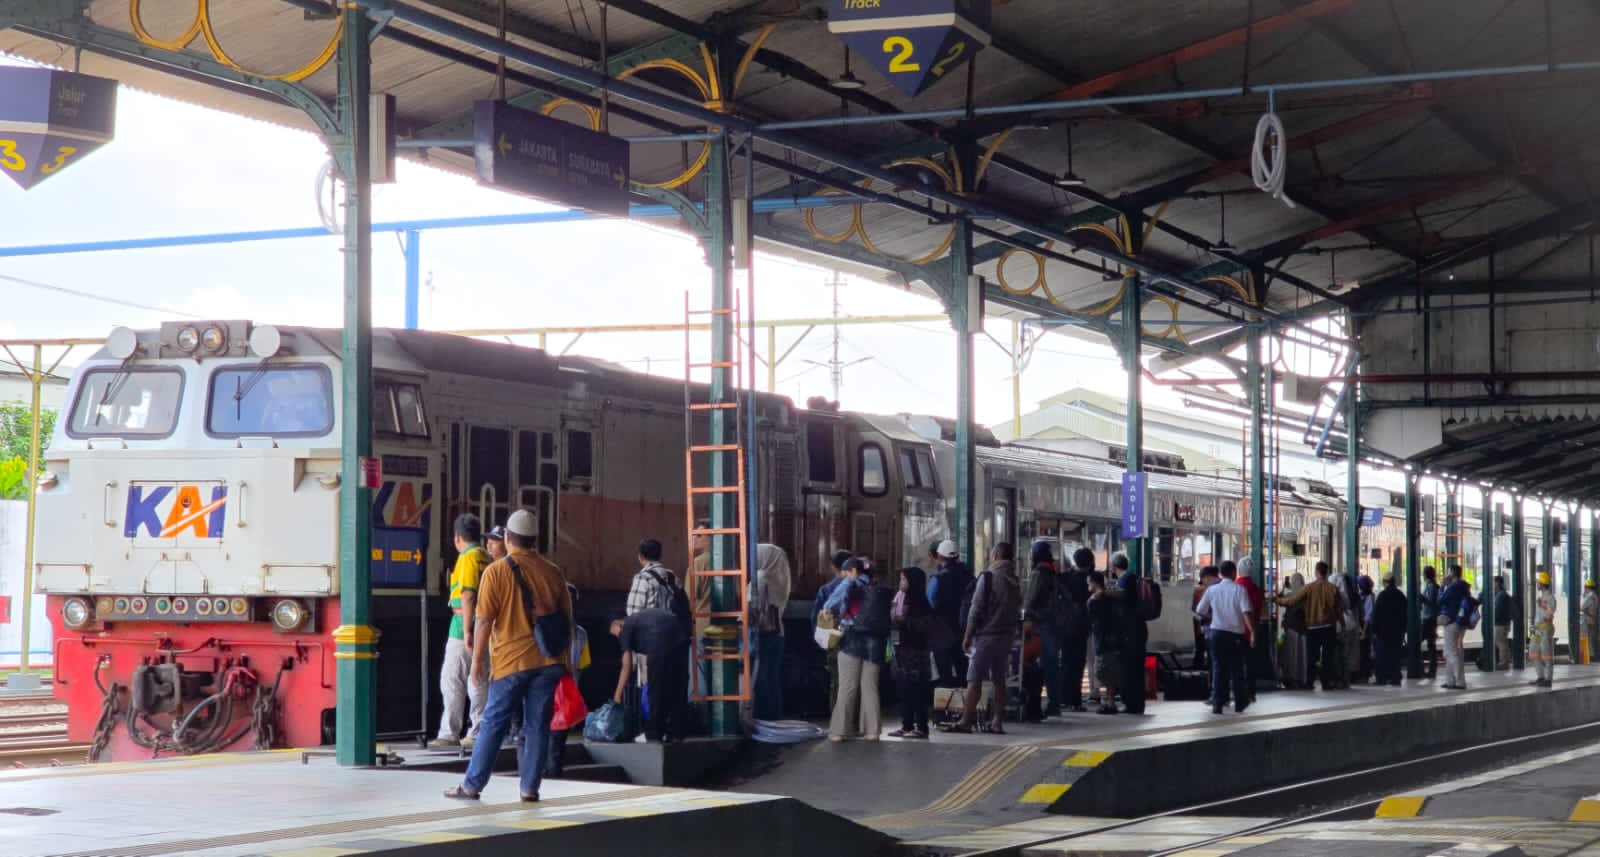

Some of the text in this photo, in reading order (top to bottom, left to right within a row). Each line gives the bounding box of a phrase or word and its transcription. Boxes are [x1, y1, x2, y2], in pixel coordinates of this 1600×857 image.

[882, 36, 921, 73] 2
[931, 42, 966, 77] 2
[0, 139, 26, 171] 3
[41, 146, 77, 174] 3
[123, 485, 229, 538] KAI
[1128, 474, 1137, 533] MADIUN
